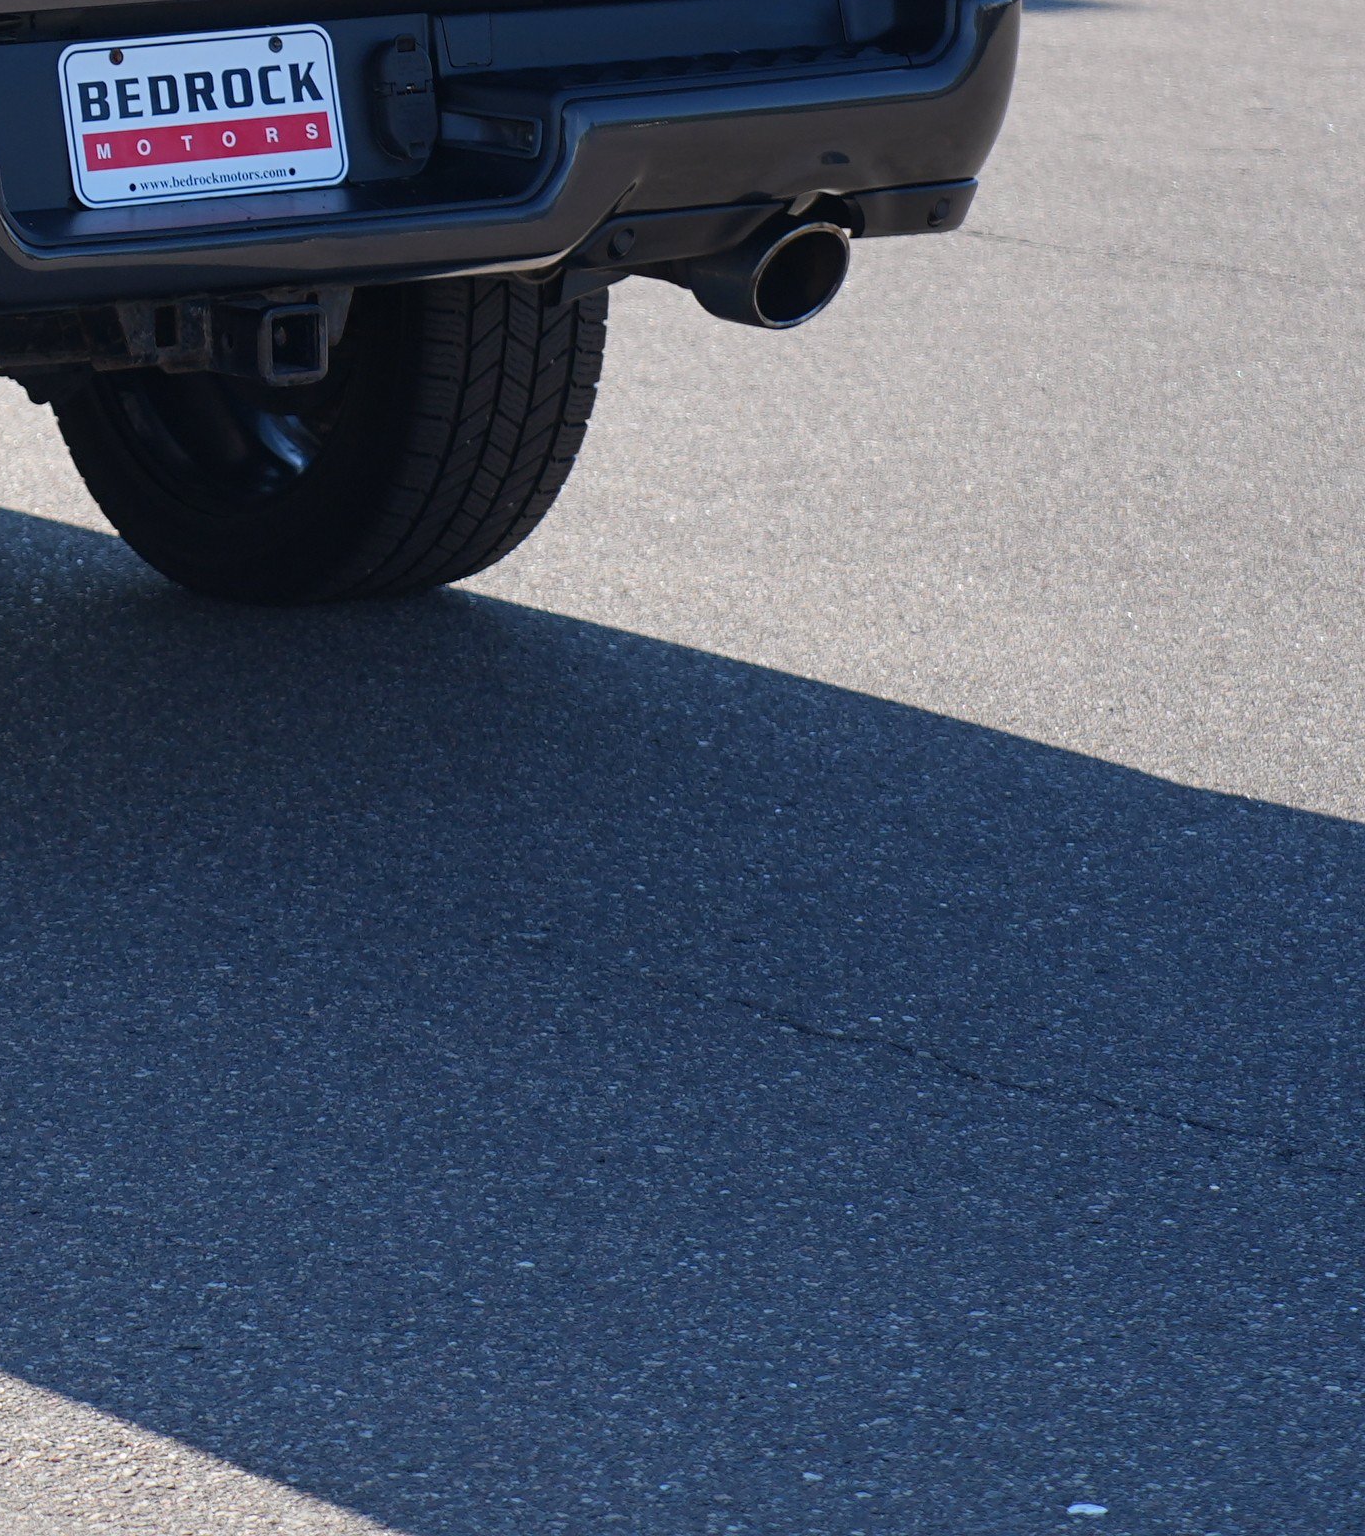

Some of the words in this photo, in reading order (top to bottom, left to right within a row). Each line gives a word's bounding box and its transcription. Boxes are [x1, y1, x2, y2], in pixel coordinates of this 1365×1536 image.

[77, 62, 324, 122] BEDROCK
[96, 124, 319, 160] MOTORS
[139, 167, 287, 191] www.bedrockmotors.com
